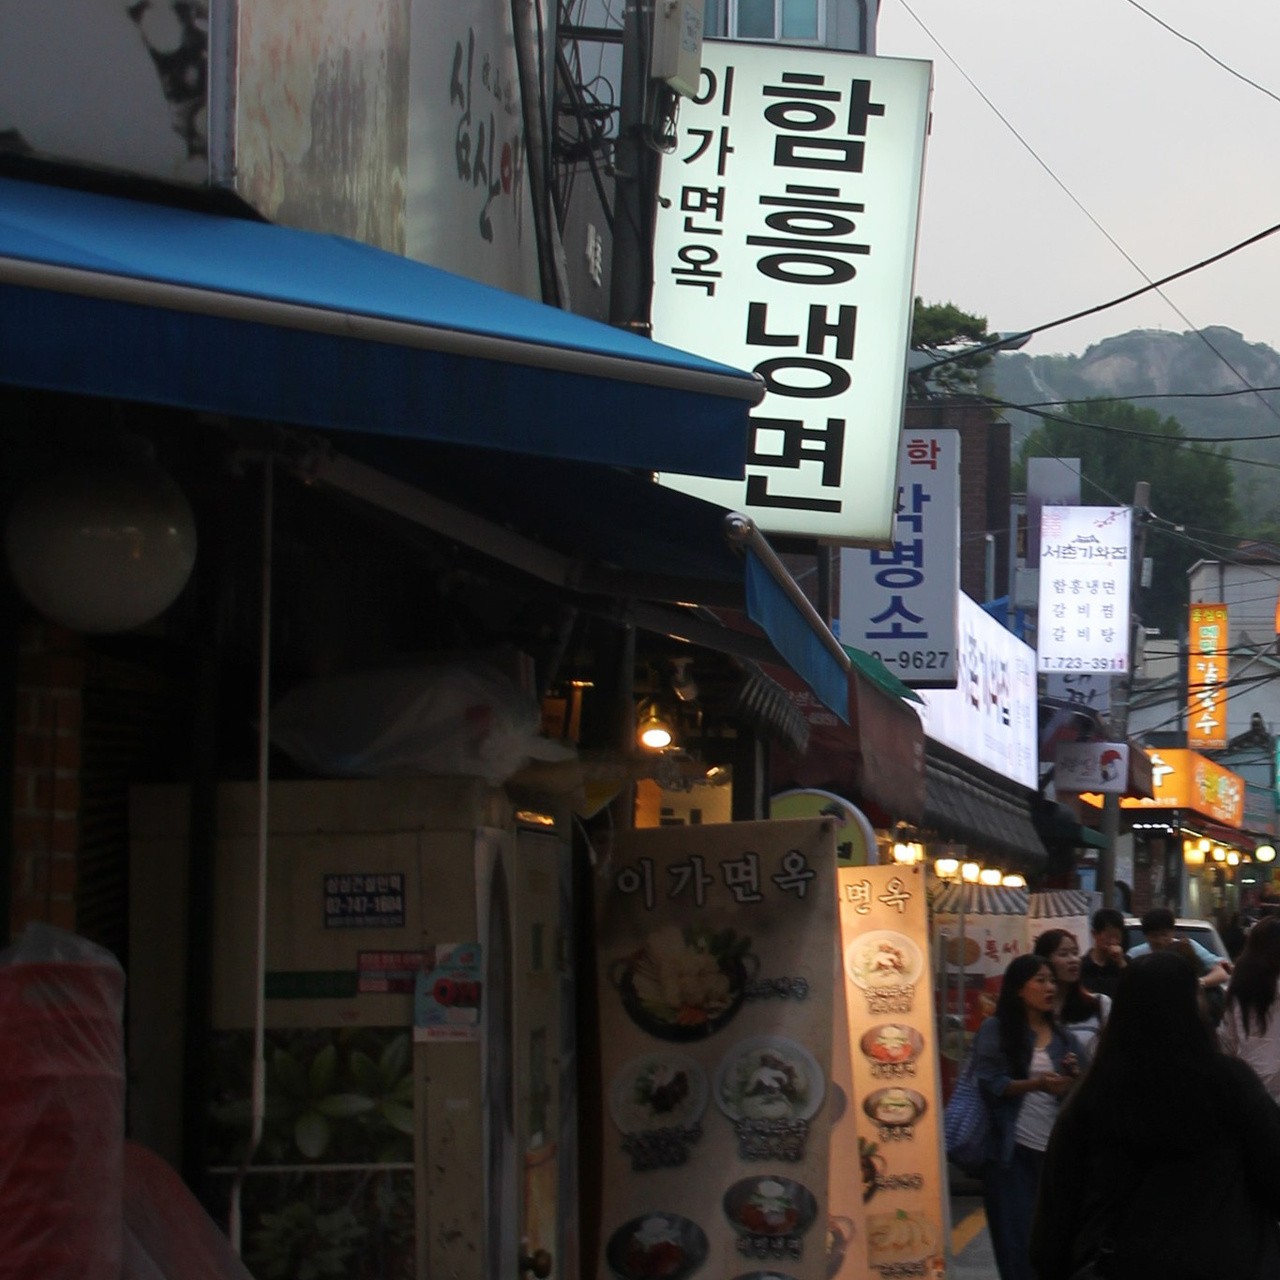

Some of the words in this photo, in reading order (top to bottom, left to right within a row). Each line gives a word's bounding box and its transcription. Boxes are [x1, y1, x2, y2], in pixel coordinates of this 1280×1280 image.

[671, 65, 735, 296] 이가면옥
[745, 72, 885, 513] 함흥냉면
[1042, 544, 1127, 560] 서촌기와집
[1052, 579, 1115, 595] 함흥냉면
[1052, 627, 1115, 642] 갈비탕
[1042, 657, 1124, 670] T.723-3911
[617, 849, 816, 911] 이가면옥
[846, 877, 911, 915] 면옥
